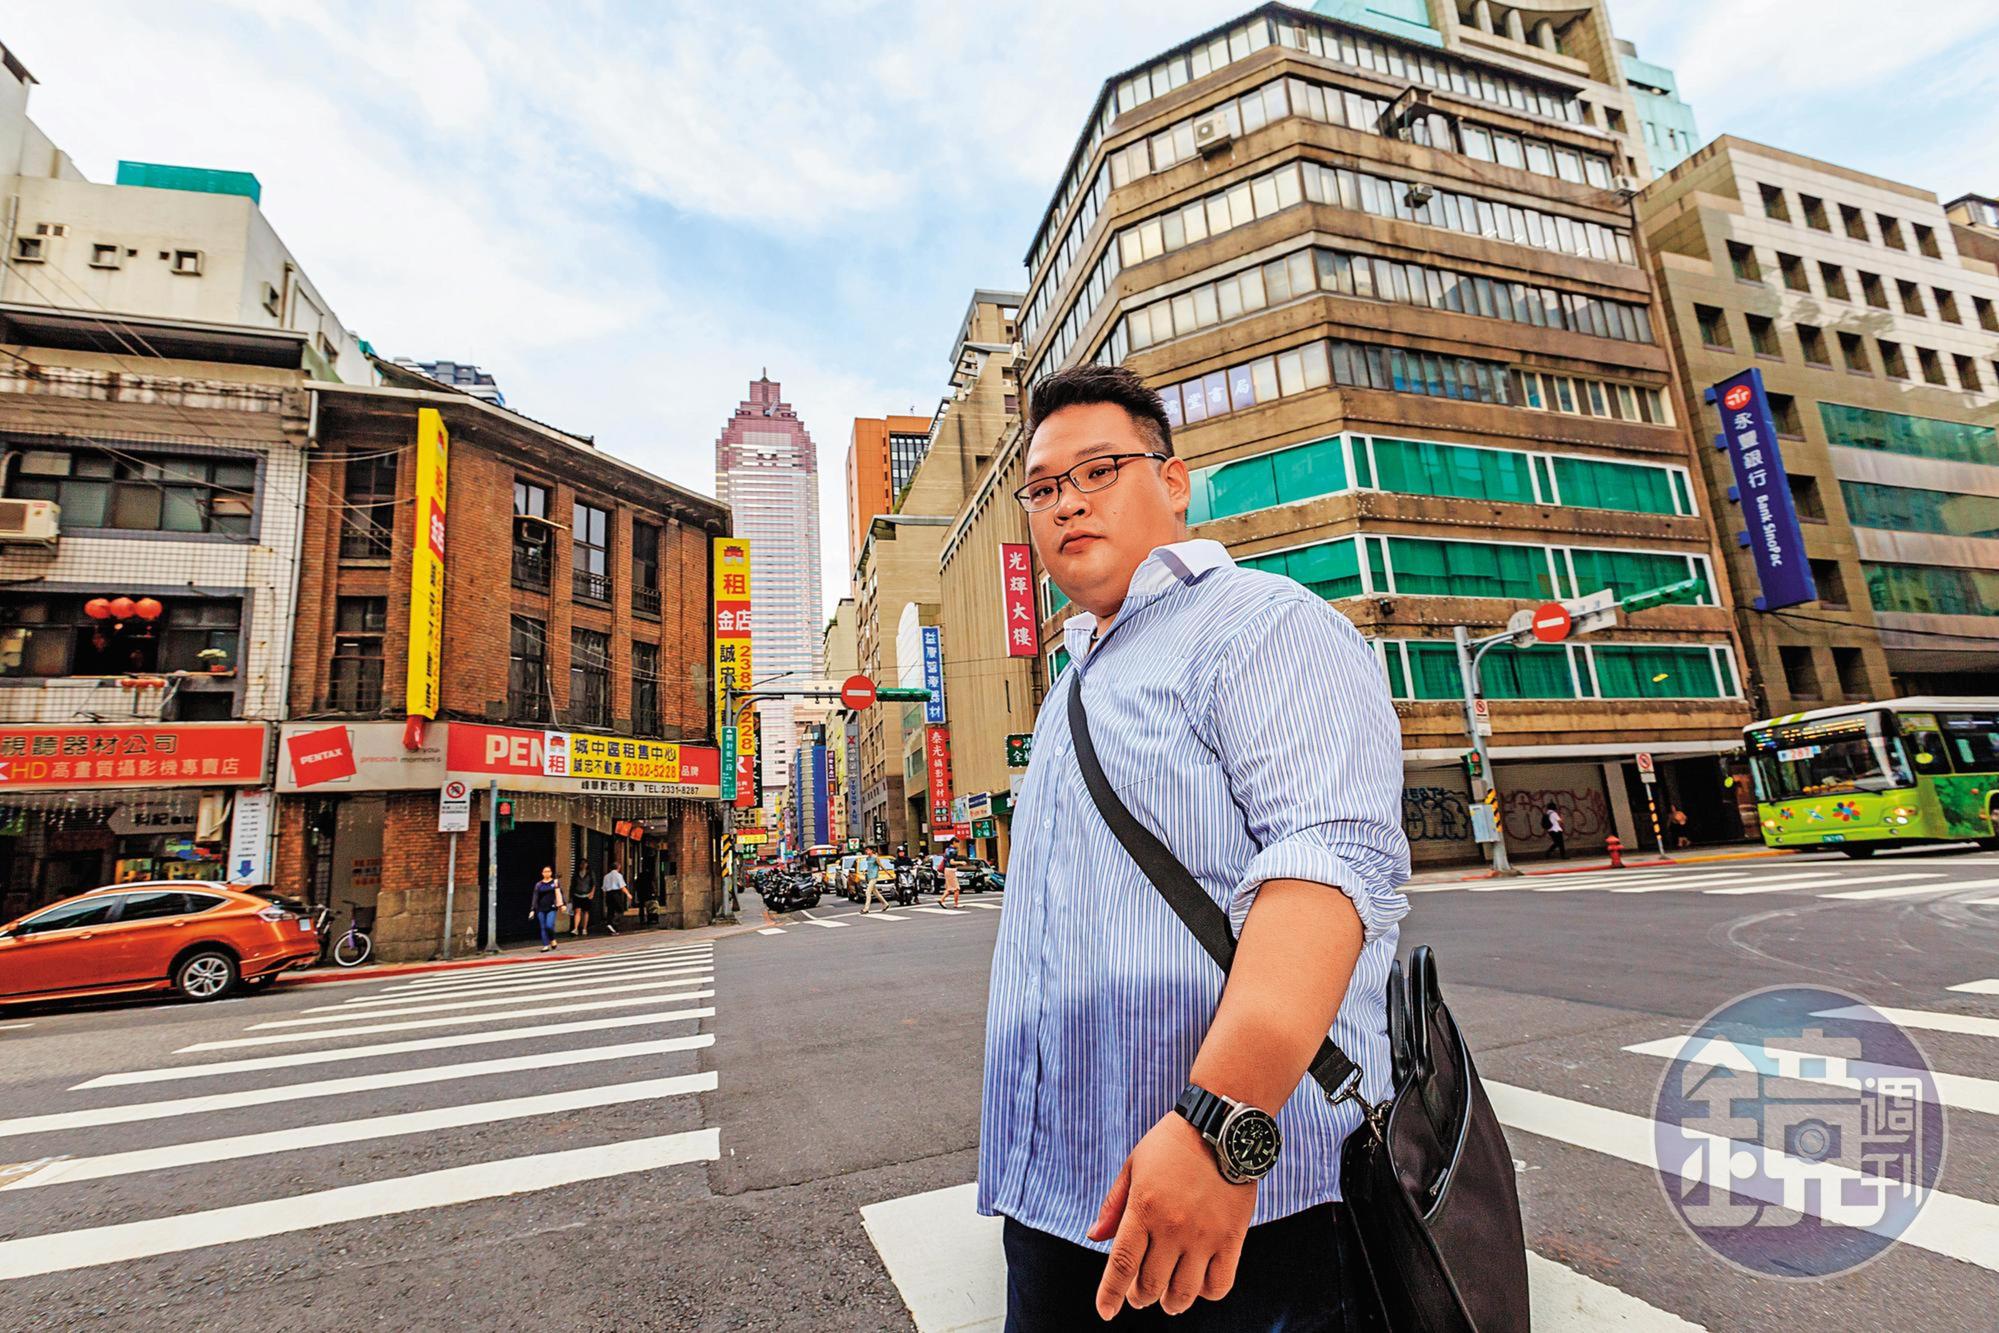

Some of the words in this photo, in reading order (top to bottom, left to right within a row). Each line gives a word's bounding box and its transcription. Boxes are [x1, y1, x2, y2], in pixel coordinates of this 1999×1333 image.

[1734, 411, 1767, 489] 永豐銀行
[1756, 494, 1773, 523] Bank
[1763, 522, 1783, 567] SinoPac
[724, 573, 746, 595] 租
[1008, 552, 1032, 647] 光輝大樓
[718, 609, 751, 631] 金店
[2, 735, 178, 757] 視聽器材公司
[300, 748, 343, 765] PENTAX
[574, 737, 677, 762] 城中區租售中心
[11, 761, 48, 780] HD
[51, 757, 240, 780] 高畫質攝影機專賣店
[548, 754, 566, 774] 租
[573, 759, 622, 775] 誠忠不動產
[625, 762, 677, 778] 2382-5228
[681, 765, 699, 777] 品牌
